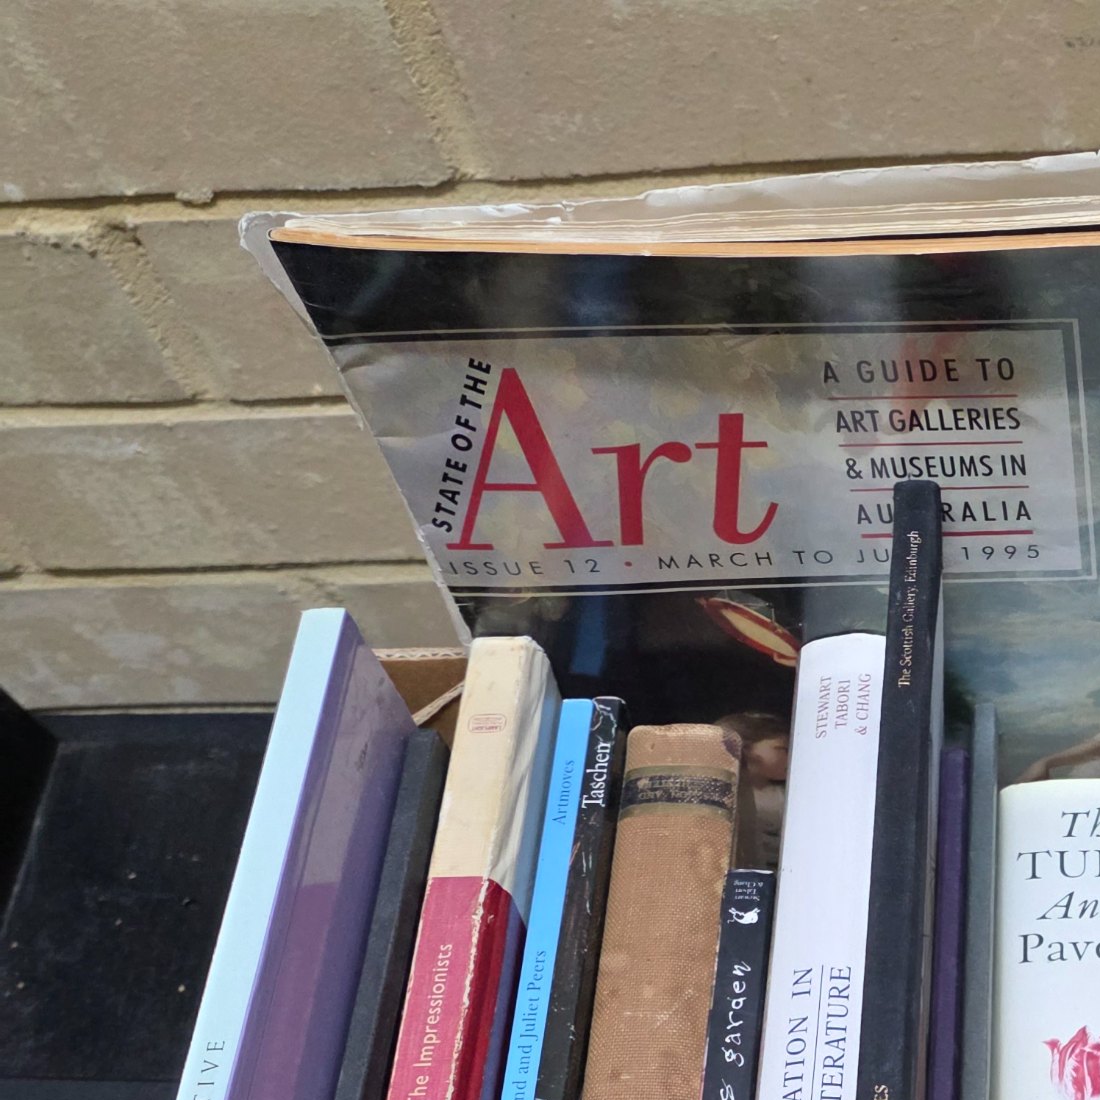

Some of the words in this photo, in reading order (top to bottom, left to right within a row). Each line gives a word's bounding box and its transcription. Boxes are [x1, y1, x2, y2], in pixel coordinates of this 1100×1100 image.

[460, 358, 492, 409] THE
[823, 362, 839, 383] A
[856, 358, 959, 383] GUIDE
[976, 358, 1014, 380] TO
[451, 415, 477, 451] OF
[836, 410, 879, 433] ART
[889, 407, 1021, 432] GALLERIES
[446, 368, 779, 550] Art
[845, 458, 862, 479] &
[870, 455, 993, 478] MUSEUMS
[1001, 454, 1026, 476] IN
[432, 458, 467, 532] STATE
[857, 500, 1032, 524] AURALIA
[449, 561, 544, 576] ISSUE
[564, 559, 600, 573] 12
[659, 552, 772, 570] MARCH
[792, 551, 833, 564] TO
[961, 545, 1040, 560] 1995
[898, 666, 911, 688] The
[905, 530, 922, 582] Edinburgh
[815, 676, 832, 739] STEWART
[835, 679, 851, 729] TABORI
[857, 673, 871, 720] CHANG
[854, 725, 867, 735] &
[552, 759, 575, 825] Artmoves
[582, 741, 611, 809] Taschen
[527, 950, 547, 993] Peers
[792, 966, 814, 1001] IN
[413, 943, 453, 1069] Impressionists
[521, 994, 540, 1041] Juliet
[516, 1042, 532, 1074] and
